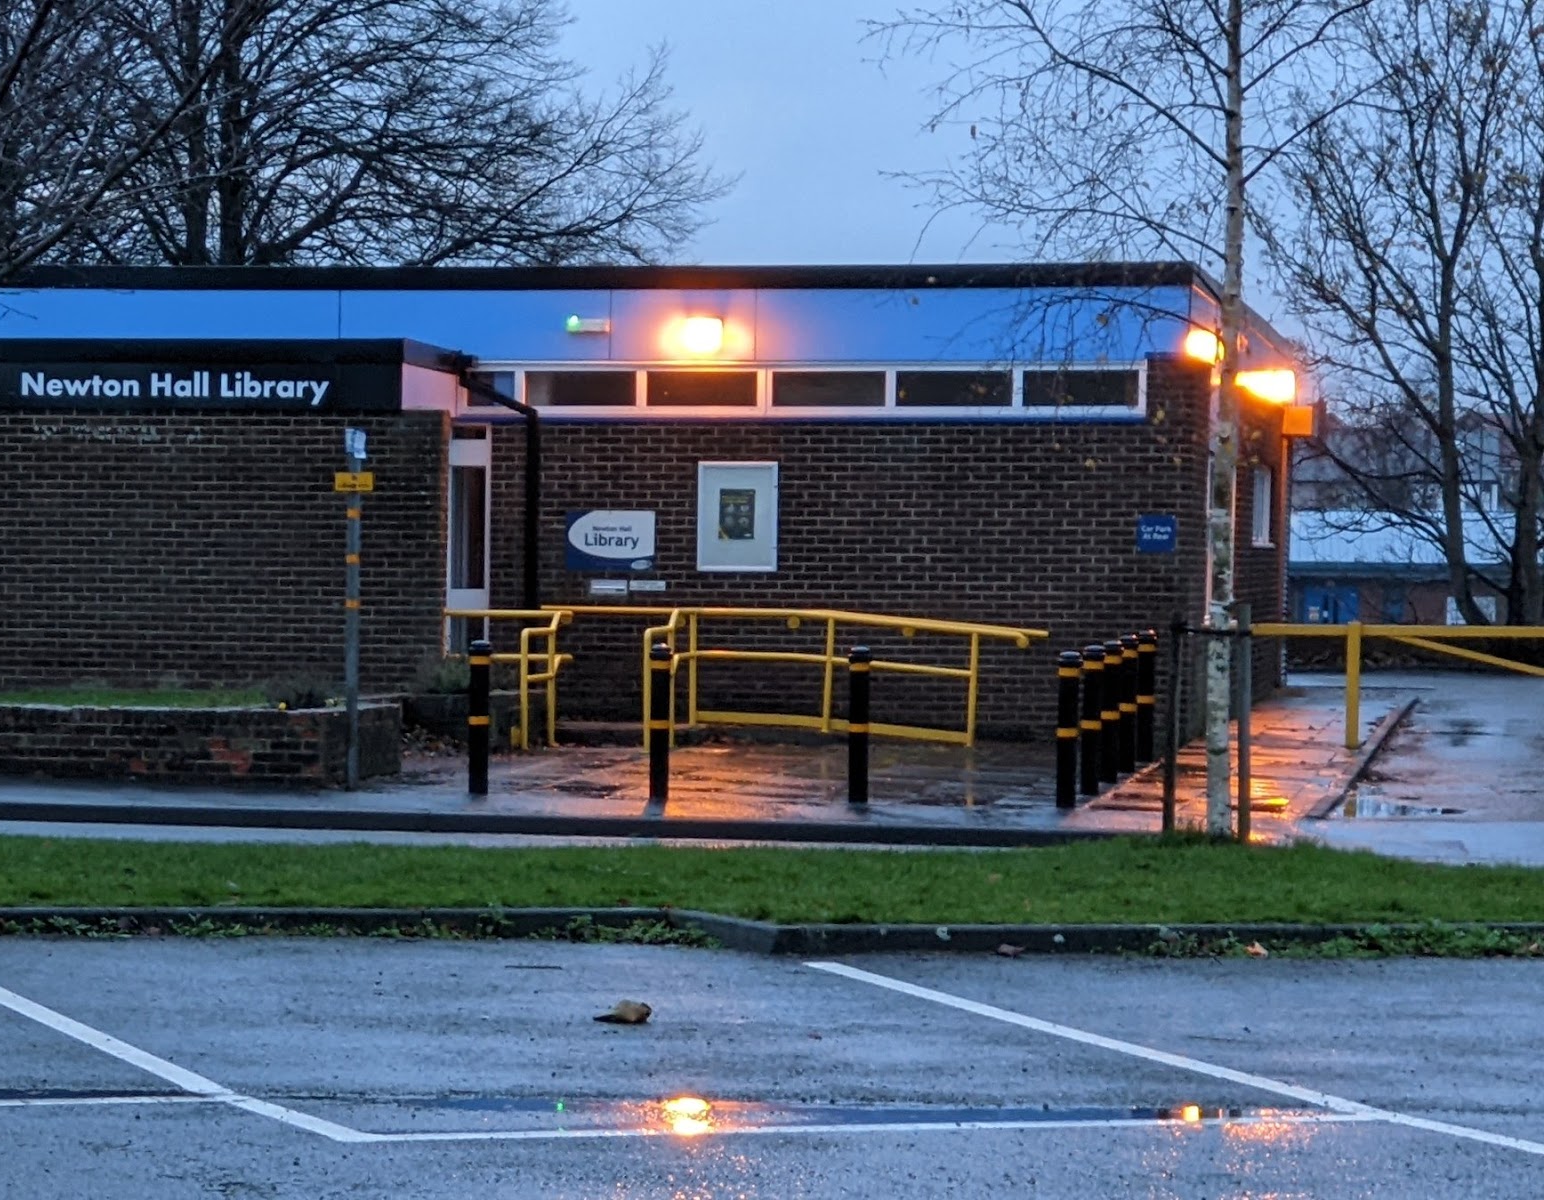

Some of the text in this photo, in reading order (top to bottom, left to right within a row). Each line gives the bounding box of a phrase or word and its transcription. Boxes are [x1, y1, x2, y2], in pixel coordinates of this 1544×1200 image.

[21, 371, 330, 406] Newton Hall Library
[584, 533, 640, 550] Library
